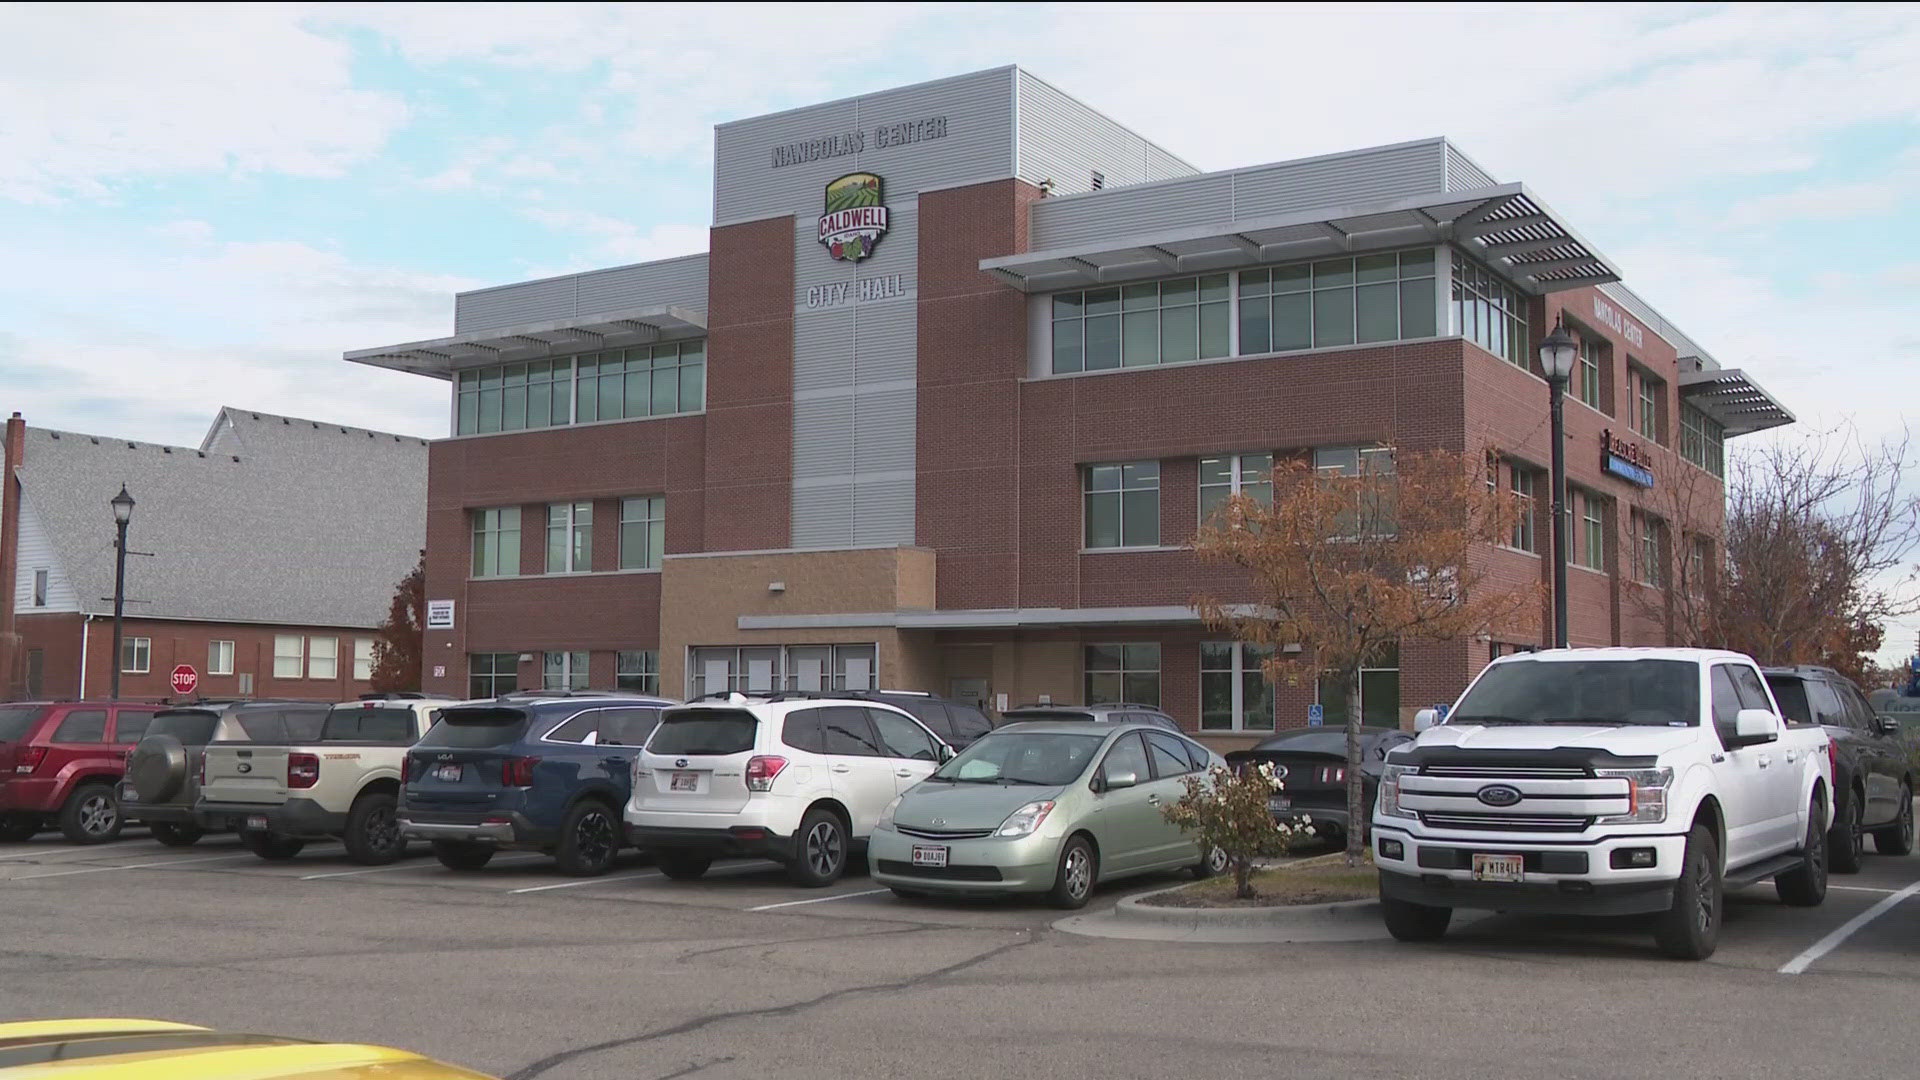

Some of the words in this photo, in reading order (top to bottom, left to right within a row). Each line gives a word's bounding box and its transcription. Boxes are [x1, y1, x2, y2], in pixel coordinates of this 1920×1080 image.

[771, 131, 864, 168] NANCOLAS
[874, 116, 947, 149] CENTER
[820, 208, 884, 236] CALDWELL
[807, 281, 848, 308] CITY
[859, 274, 905, 300] HALL
[173, 673, 196, 685] STOP
